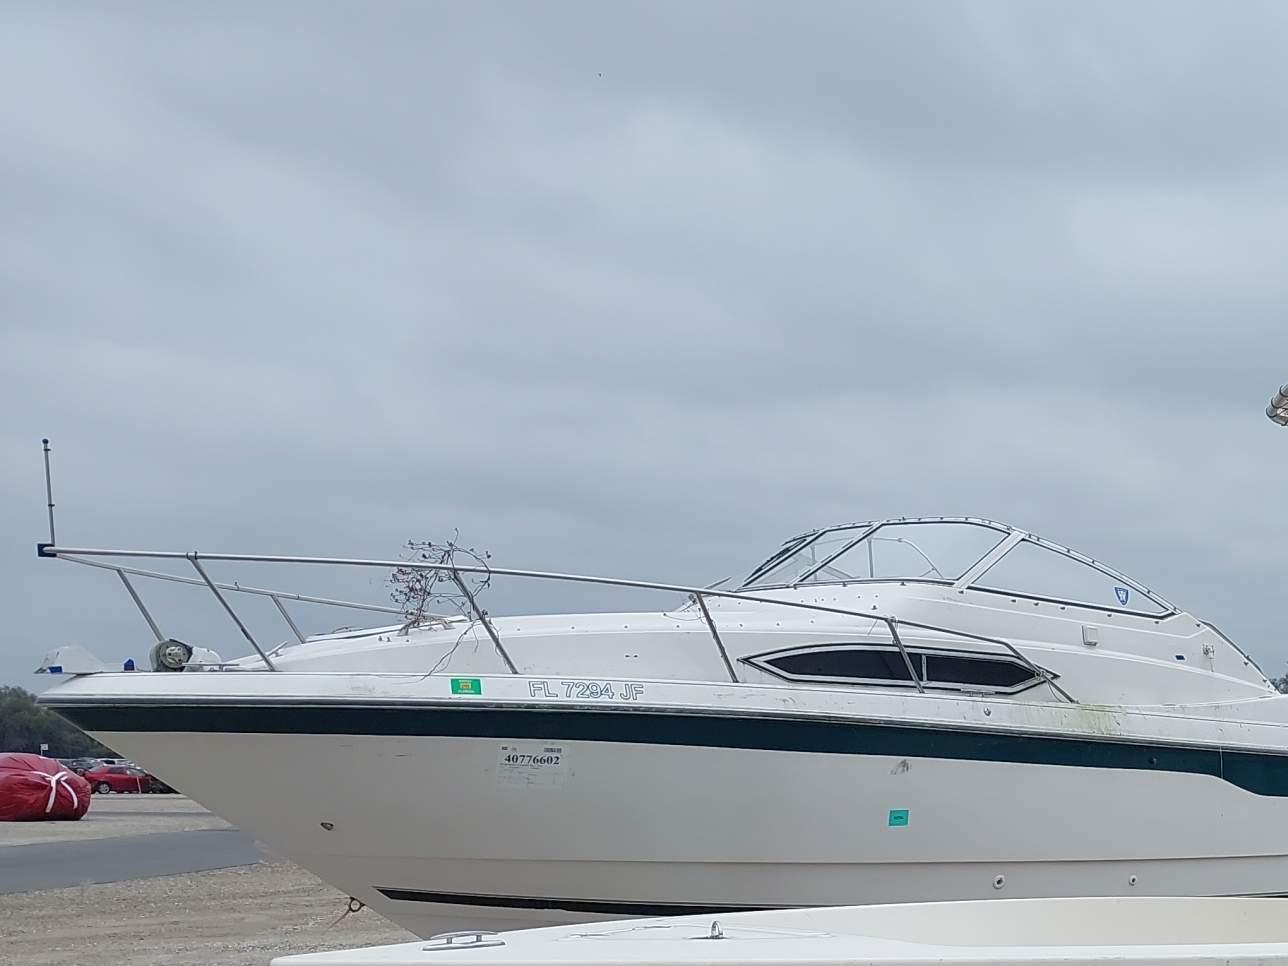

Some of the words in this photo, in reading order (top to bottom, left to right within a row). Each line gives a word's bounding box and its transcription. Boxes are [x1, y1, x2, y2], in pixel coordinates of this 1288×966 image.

[528, 681, 558, 697] FL
[561, 681, 615, 699] 7294
[620, 684, 644, 700] JF
[504, 754, 560, 765] 40776602
